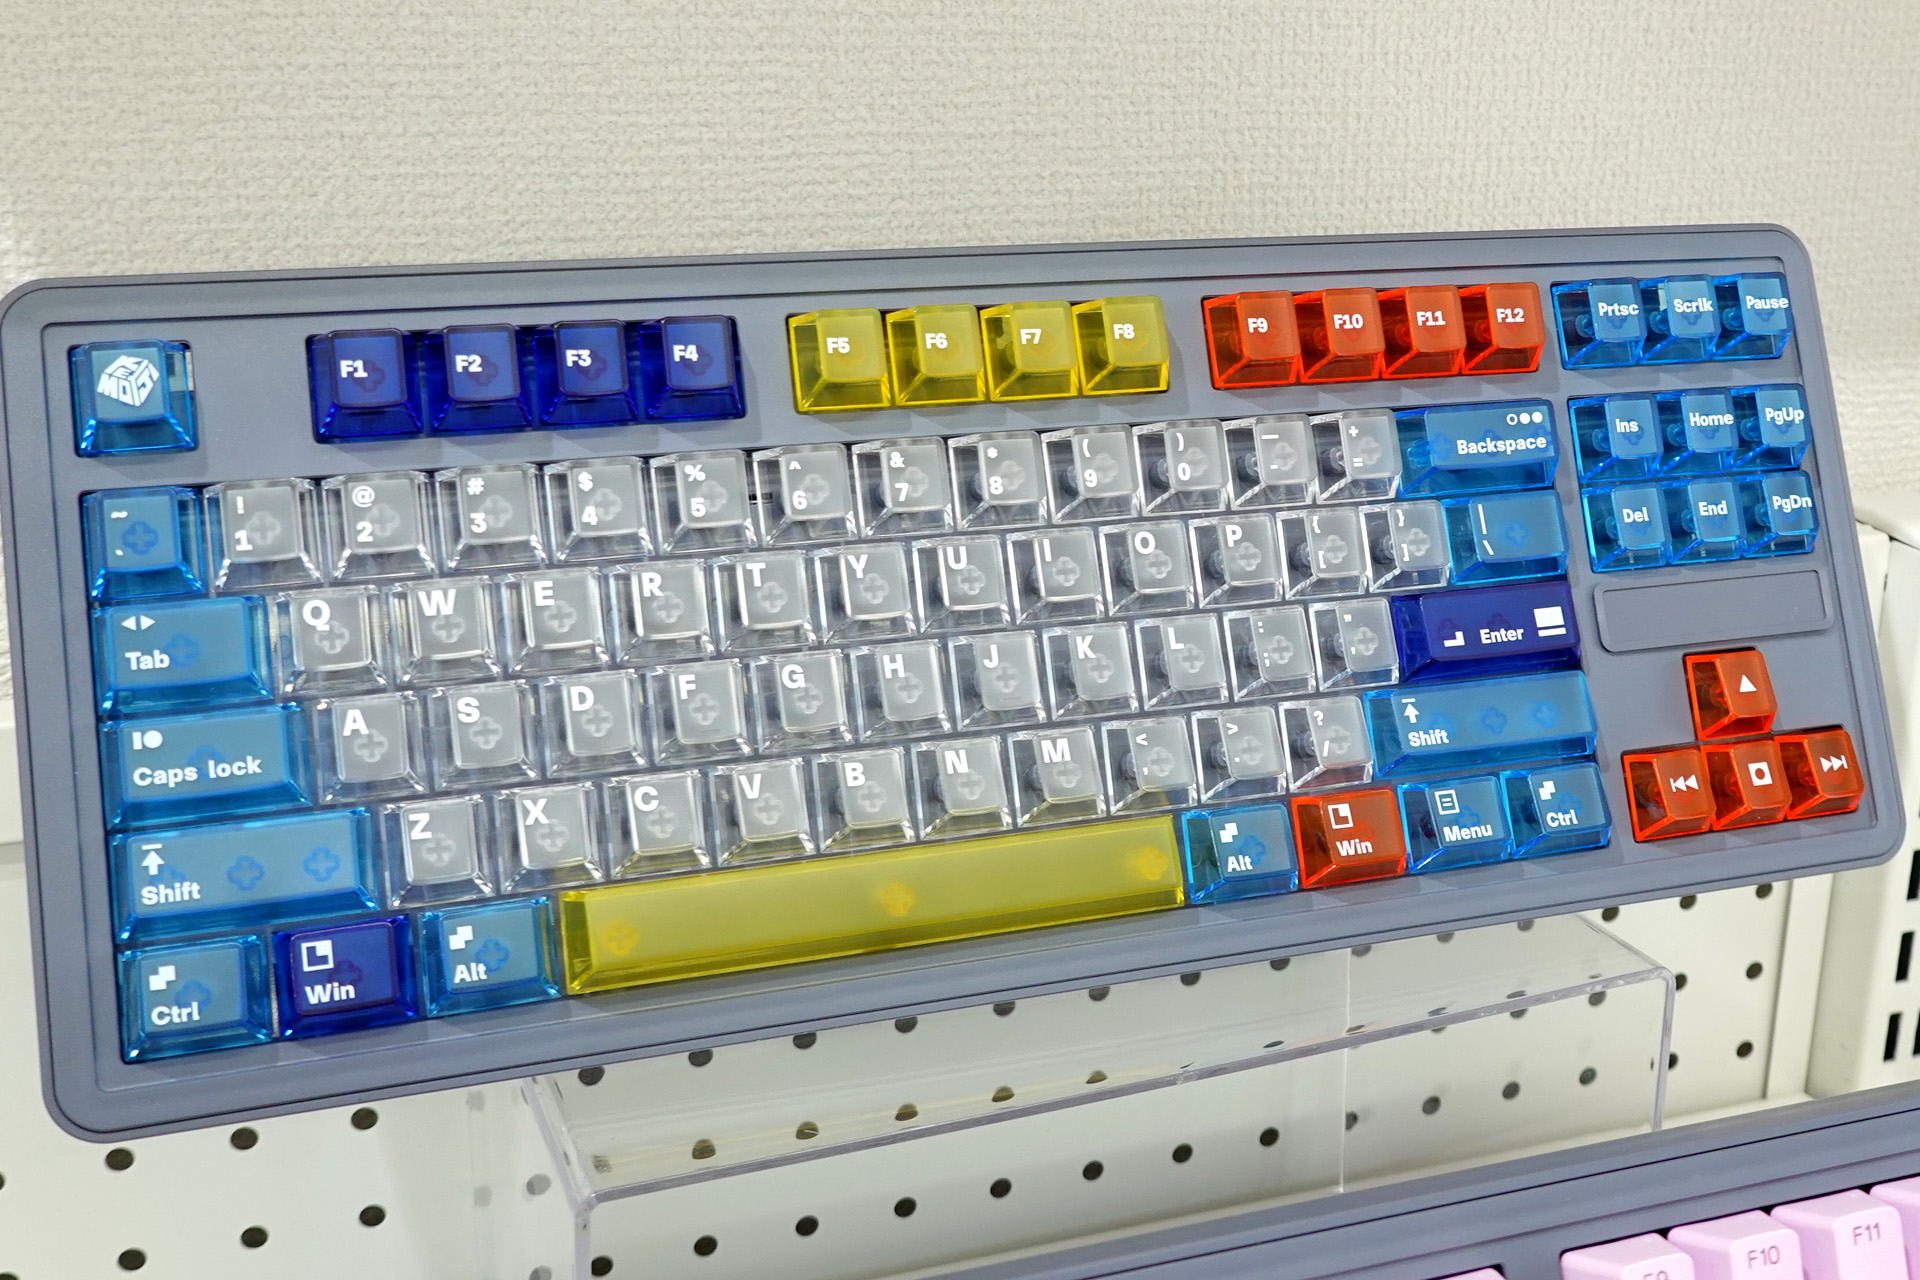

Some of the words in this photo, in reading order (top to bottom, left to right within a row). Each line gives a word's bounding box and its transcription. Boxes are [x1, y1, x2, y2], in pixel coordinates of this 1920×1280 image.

[1598, 303, 1639, 316] Prtsc
[1746, 296, 1788, 309] Pause
[1248, 318, 1267, 332] F9
[1334, 314, 1363, 328] F10
[1417, 311, 1445, 325] F11
[1497, 308, 1524, 322] F12
[926, 333, 947, 348] F6
[1020, 329, 1041, 344] F7
[1114, 324, 1134, 339] F8
[674, 345, 698, 361] F4
[827, 337, 850, 353] F5
[456, 355, 482, 372] F2
[566, 350, 591, 366] F3
[341, 360, 368, 377] F1
[1616, 419, 1638, 432] Ins
[1689, 413, 1733, 426] Home
[1765, 407, 1804, 425] PgUp
[1457, 437, 1546, 454] Backspace
[1084, 469, 1097, 487] 9
[1178, 463, 1190, 480] 0
[895, 483, 909, 501] 7
[990, 476, 1003, 494] 8
[691, 498, 706, 517] 5
[793, 491, 807, 509] 6
[1699, 500, 1727, 515] End
[1772, 495, 1812, 512] PgDn
[471, 512, 487, 533] 3
[582, 506, 598, 525] 4
[1623, 507, 1649, 522] Del
[235, 530, 252, 550] 1
[357, 521, 373, 542] 2
[1225, 525, 1246, 547] P
[1134, 531, 1156, 555] O
[847, 554, 868, 578] Y
[947, 546, 967, 569] U
[642, 572, 664, 597] R
[746, 563, 766, 586] T
[418, 589, 456, 616] W
[534, 581, 555, 606] E
[303, 600, 330, 631] Q
[1168, 627, 1184, 649] L
[1480, 629, 1523, 643] Enter
[983, 644, 998, 668] J
[1076, 635, 1096, 659] K
[125, 650, 169, 670] Tab
[883, 654, 905, 678] H
[782, 664, 806, 688] G
[679, 674, 696, 699] F
[570, 686, 594, 711] D
[457, 697, 480, 723] S
[343, 709, 369, 736] A
[1408, 729, 1449, 746] Shift
[1041, 738, 1071, 763] M
[134, 767, 197, 787] Caps
[209, 756, 262, 778] lock
[945, 750, 969, 774] N
[845, 762, 865, 786] B
[738, 773, 762, 799] V
[635, 786, 659, 811] C
[523, 799, 550, 825] X
[1547, 810, 1578, 827] Ctrl
[408, 813, 432, 840] Z
[1443, 825, 1492, 841] Menu
[1336, 839, 1372, 856] Win
[1228, 855, 1252, 872] Alt
[142, 882, 200, 904] Shift
[455, 963, 487, 983] Alt
[305, 982, 355, 1004] Win
[152, 1002, 200, 1025] Ctrl
[1852, 1222, 1882, 1246] F11
[1747, 1245, 1780, 1268] F10
